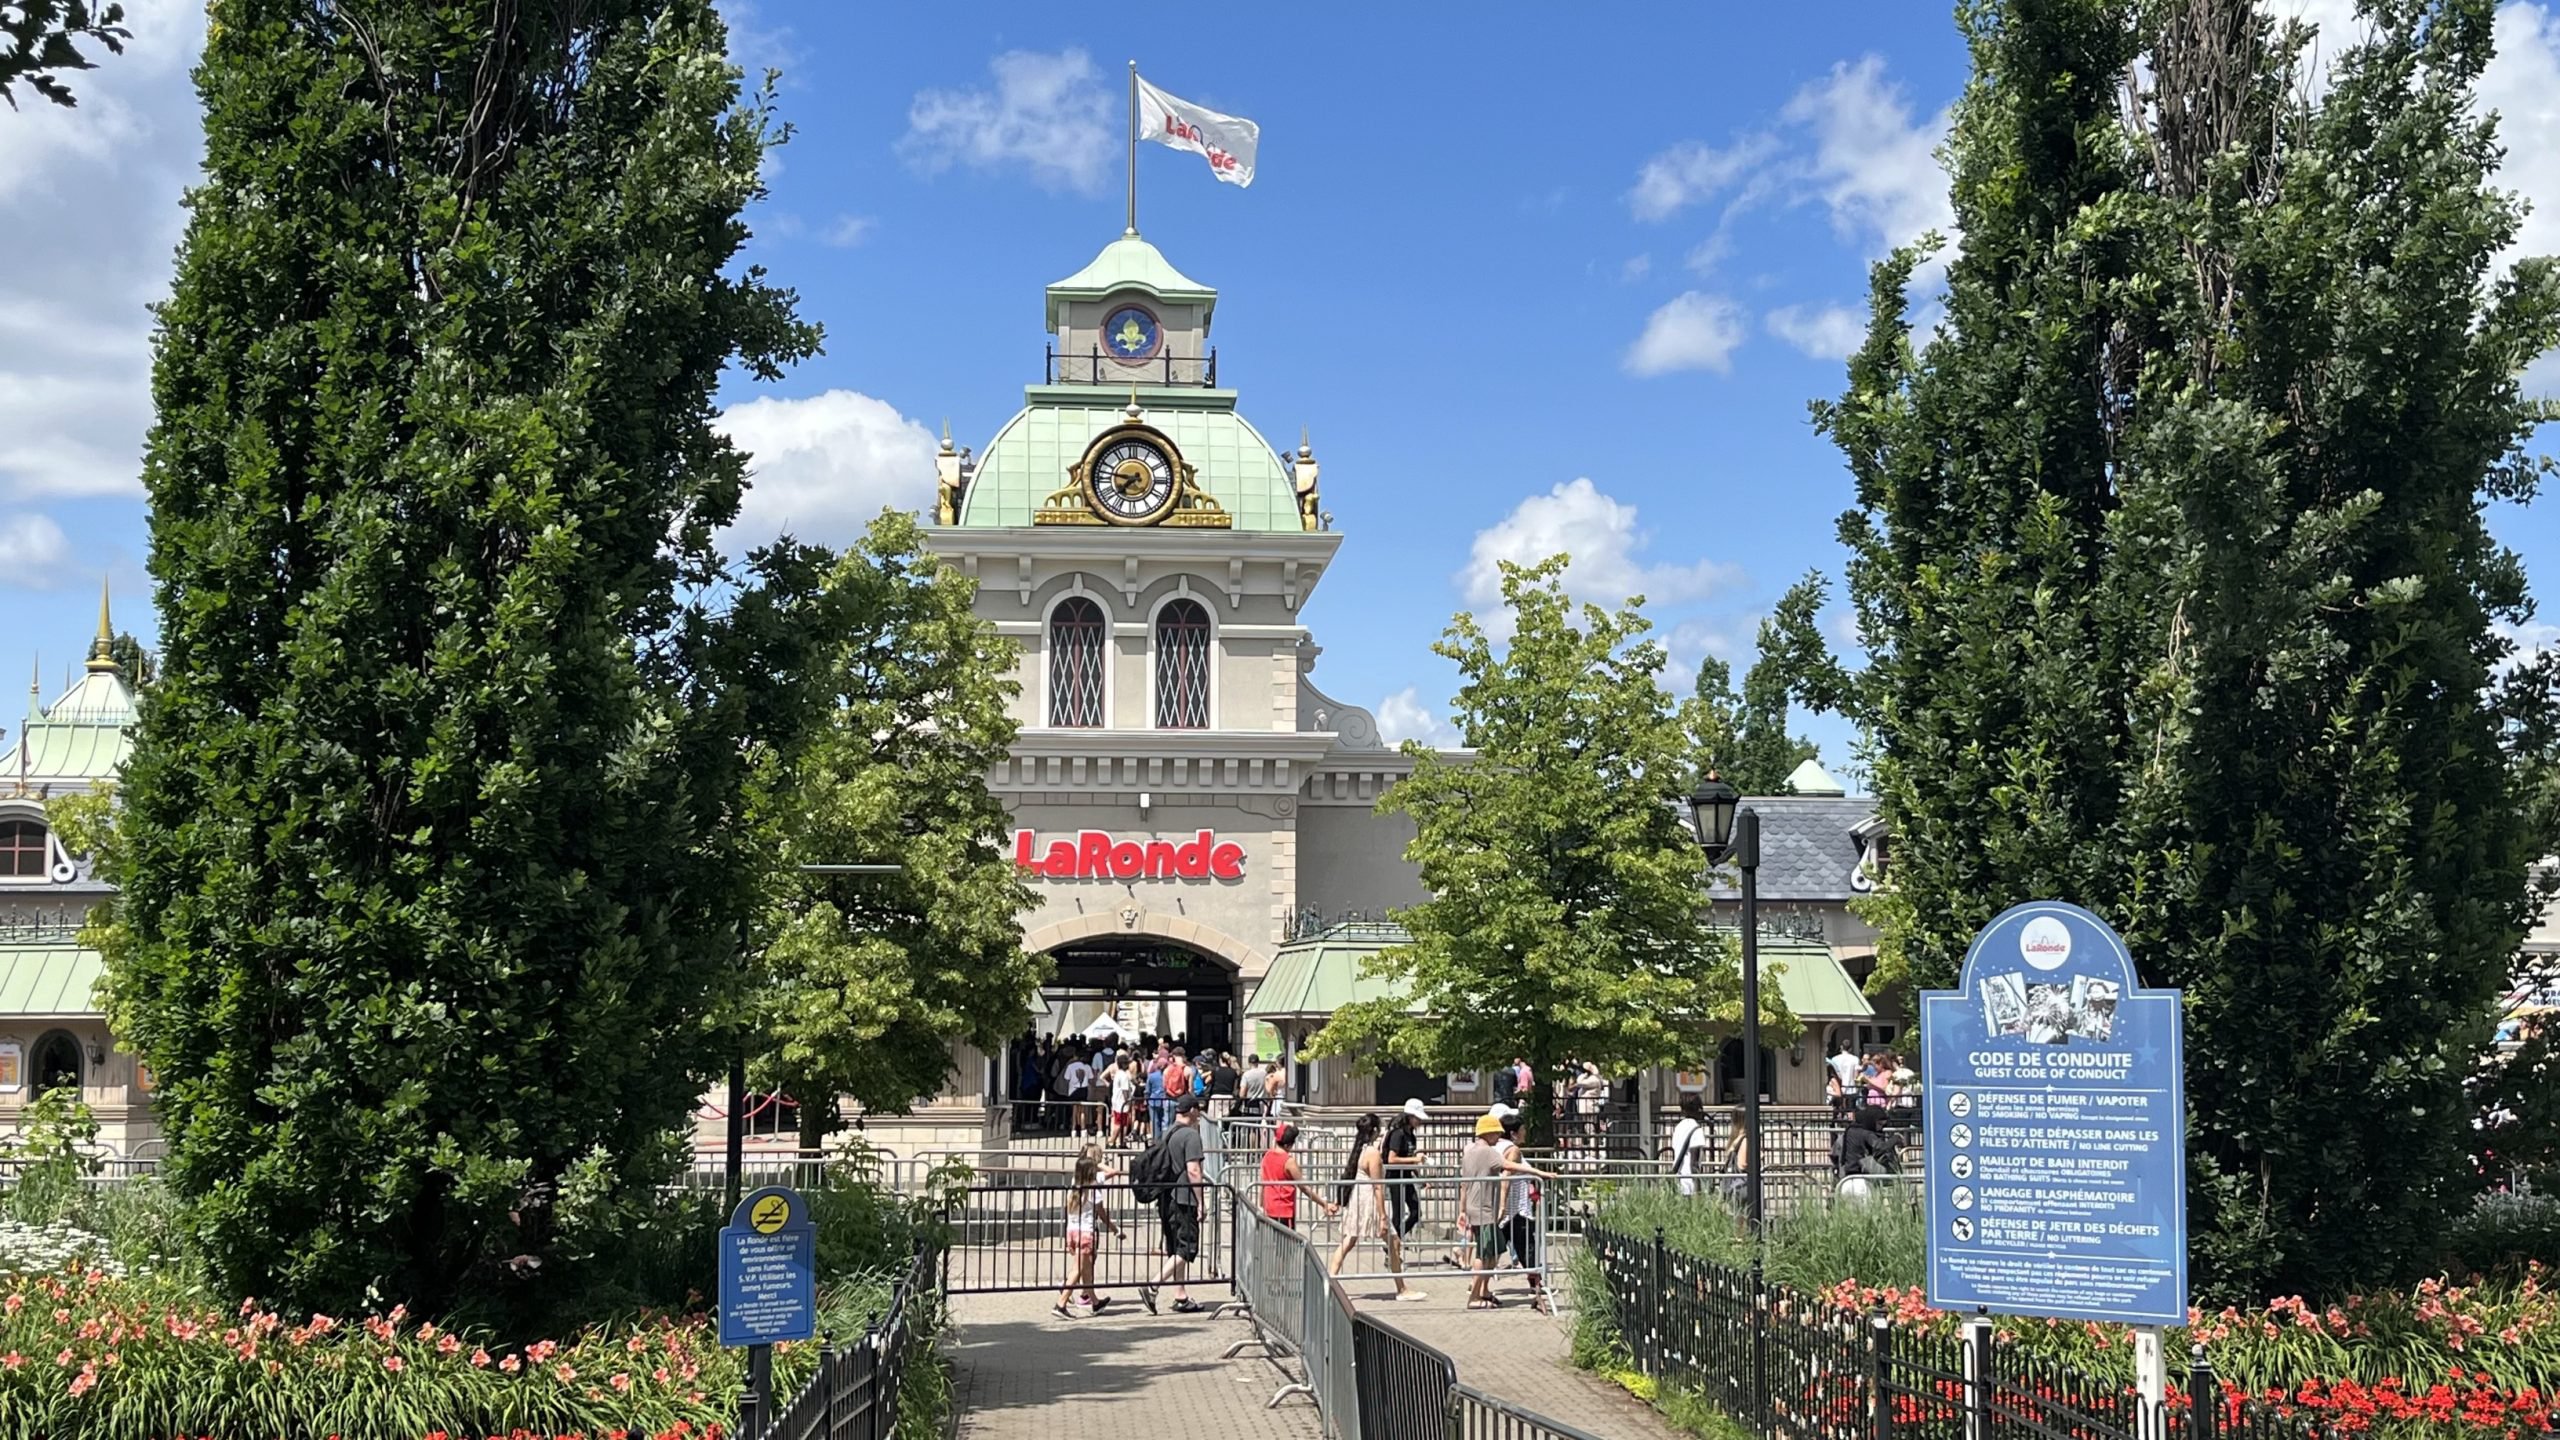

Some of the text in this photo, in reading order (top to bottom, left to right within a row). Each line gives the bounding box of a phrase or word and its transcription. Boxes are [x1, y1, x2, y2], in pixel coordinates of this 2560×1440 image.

[1014, 828, 1247, 880] LaRonde
[2026, 944, 2066, 952] LaRonde
[1969, 1052, 2132, 1067] CODE DE CONDUITE
[1975, 1068, 2126, 1079] GUEST CODE OF CONDUCT
[1978, 1091, 2148, 1107] DÉFENSE DE FUMER / VAPOTER
[1979, 1124, 2159, 1141] DÉFENSE DE DÉPASSER DANS LES
[1980, 1138, 2008, 1147] FILES
[2011, 1139, 2070, 1149] D'ATTENTE
[2072, 1140, 2076, 1151] /
[2094, 1143, 2112, 1151] LINE
[2114, 1144, 2148, 1152] CUTTING
[1980, 1156, 2129, 1170] MAILLOT DE BAIN INTERDIT
[1980, 1187, 2135, 1202] LANGAGE BLASPHÉMATOIRE
[1981, 1216, 2160, 1236] DÉFENSE DE JETER DES DÉCHETS
[1981, 1229, 2101, 1244] PAR TERRE / NO LITTERING
[758, 1292, 777, 1300] Merci
